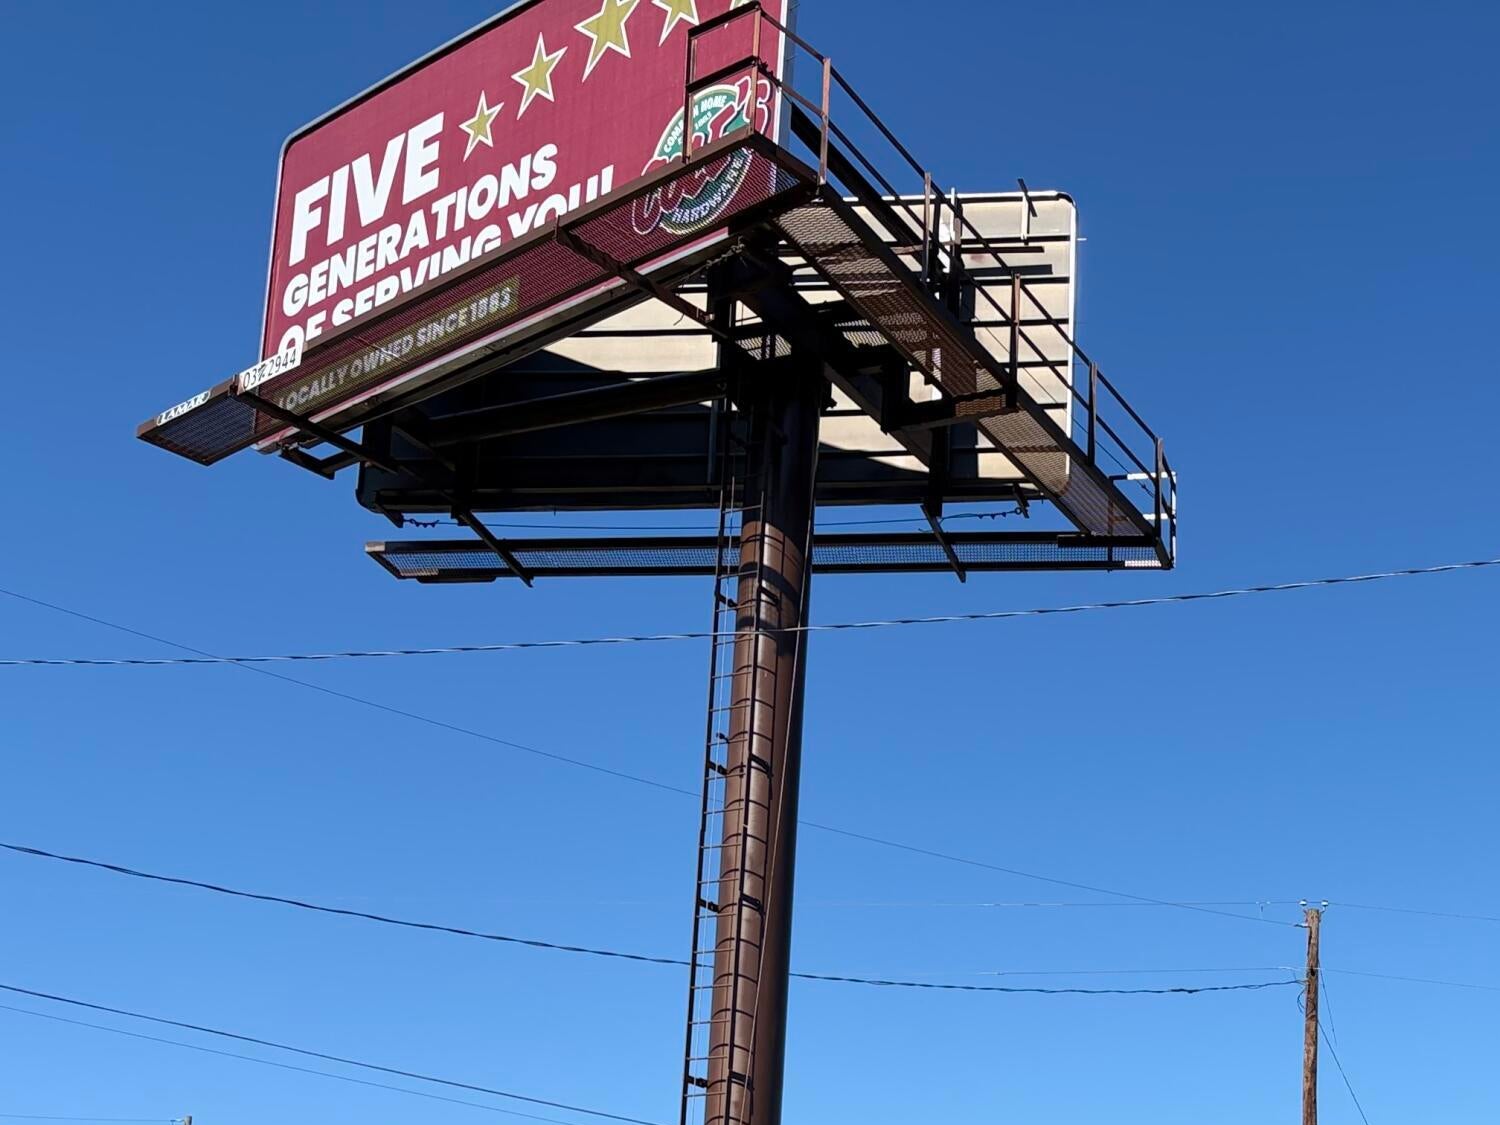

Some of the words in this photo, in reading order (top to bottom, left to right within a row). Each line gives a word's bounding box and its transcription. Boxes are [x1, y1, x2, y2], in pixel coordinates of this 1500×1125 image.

[289, 111, 444, 267] FIVE
[664, 119, 684, 153] COM
[700, 95, 727, 113] HOME
[278, 310, 327, 356] OF
[332, 224, 501, 327] SERVING
[282, 143, 557, 317] GENERATIONS
[349, 334, 414, 379] OWNED
[416, 308, 468, 347] SINCE
